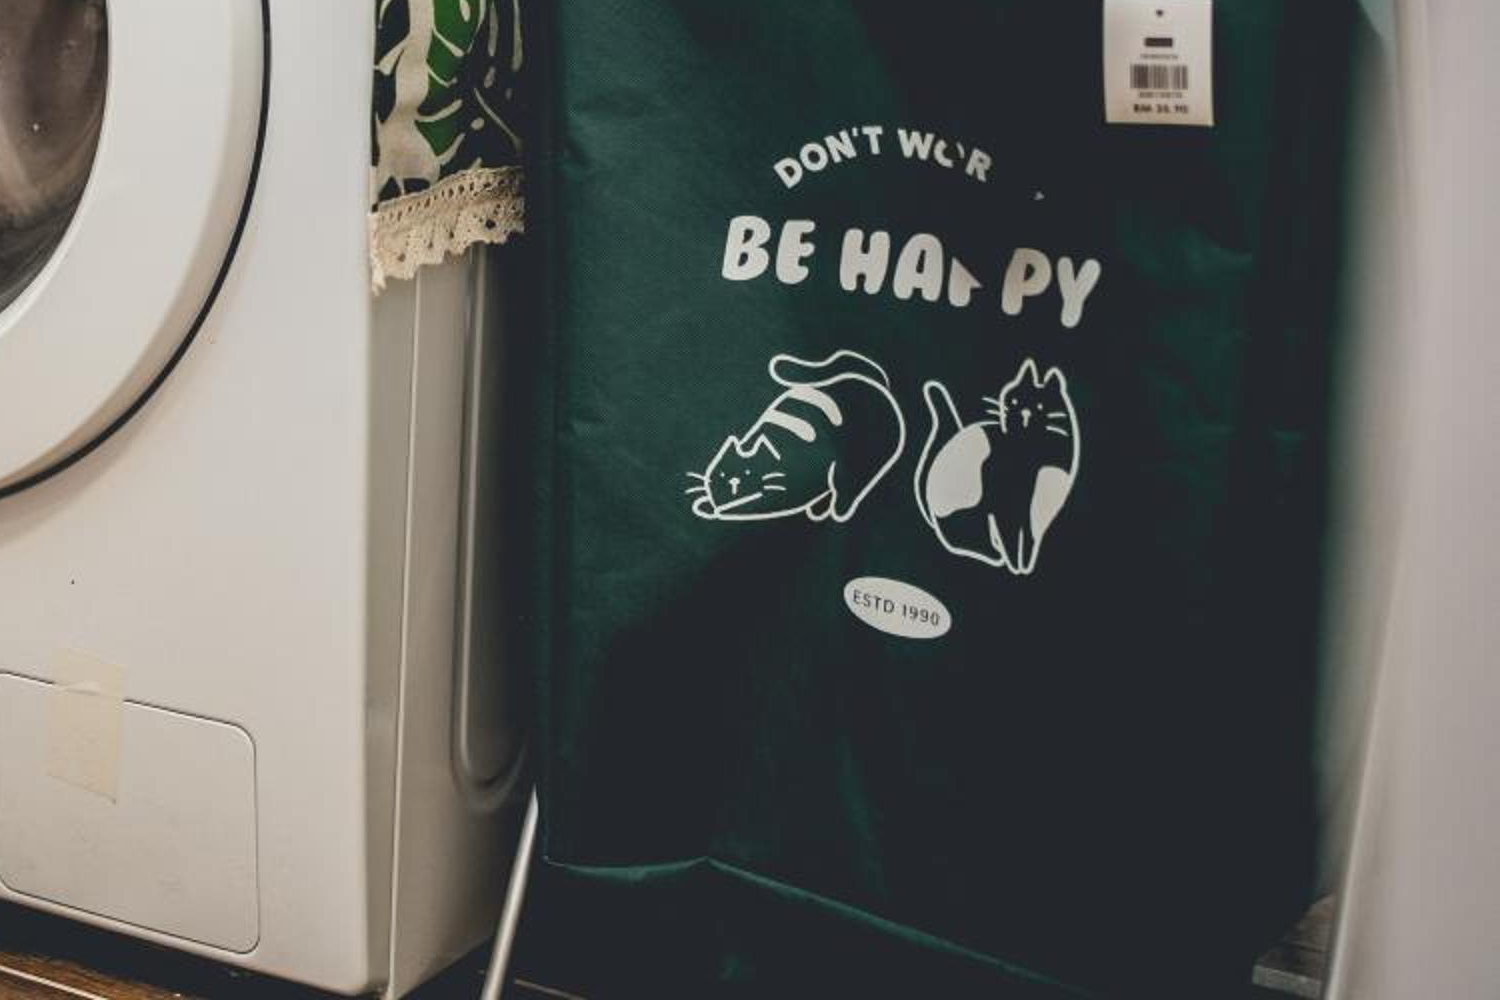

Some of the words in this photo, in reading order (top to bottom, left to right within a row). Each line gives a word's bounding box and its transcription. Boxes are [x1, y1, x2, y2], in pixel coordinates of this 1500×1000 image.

[772, 126, 884, 189] DON'T
[721, 215, 816, 285] BE
[852, 589, 895, 613] ESTD
[902, 604, 940, 626] 1990
